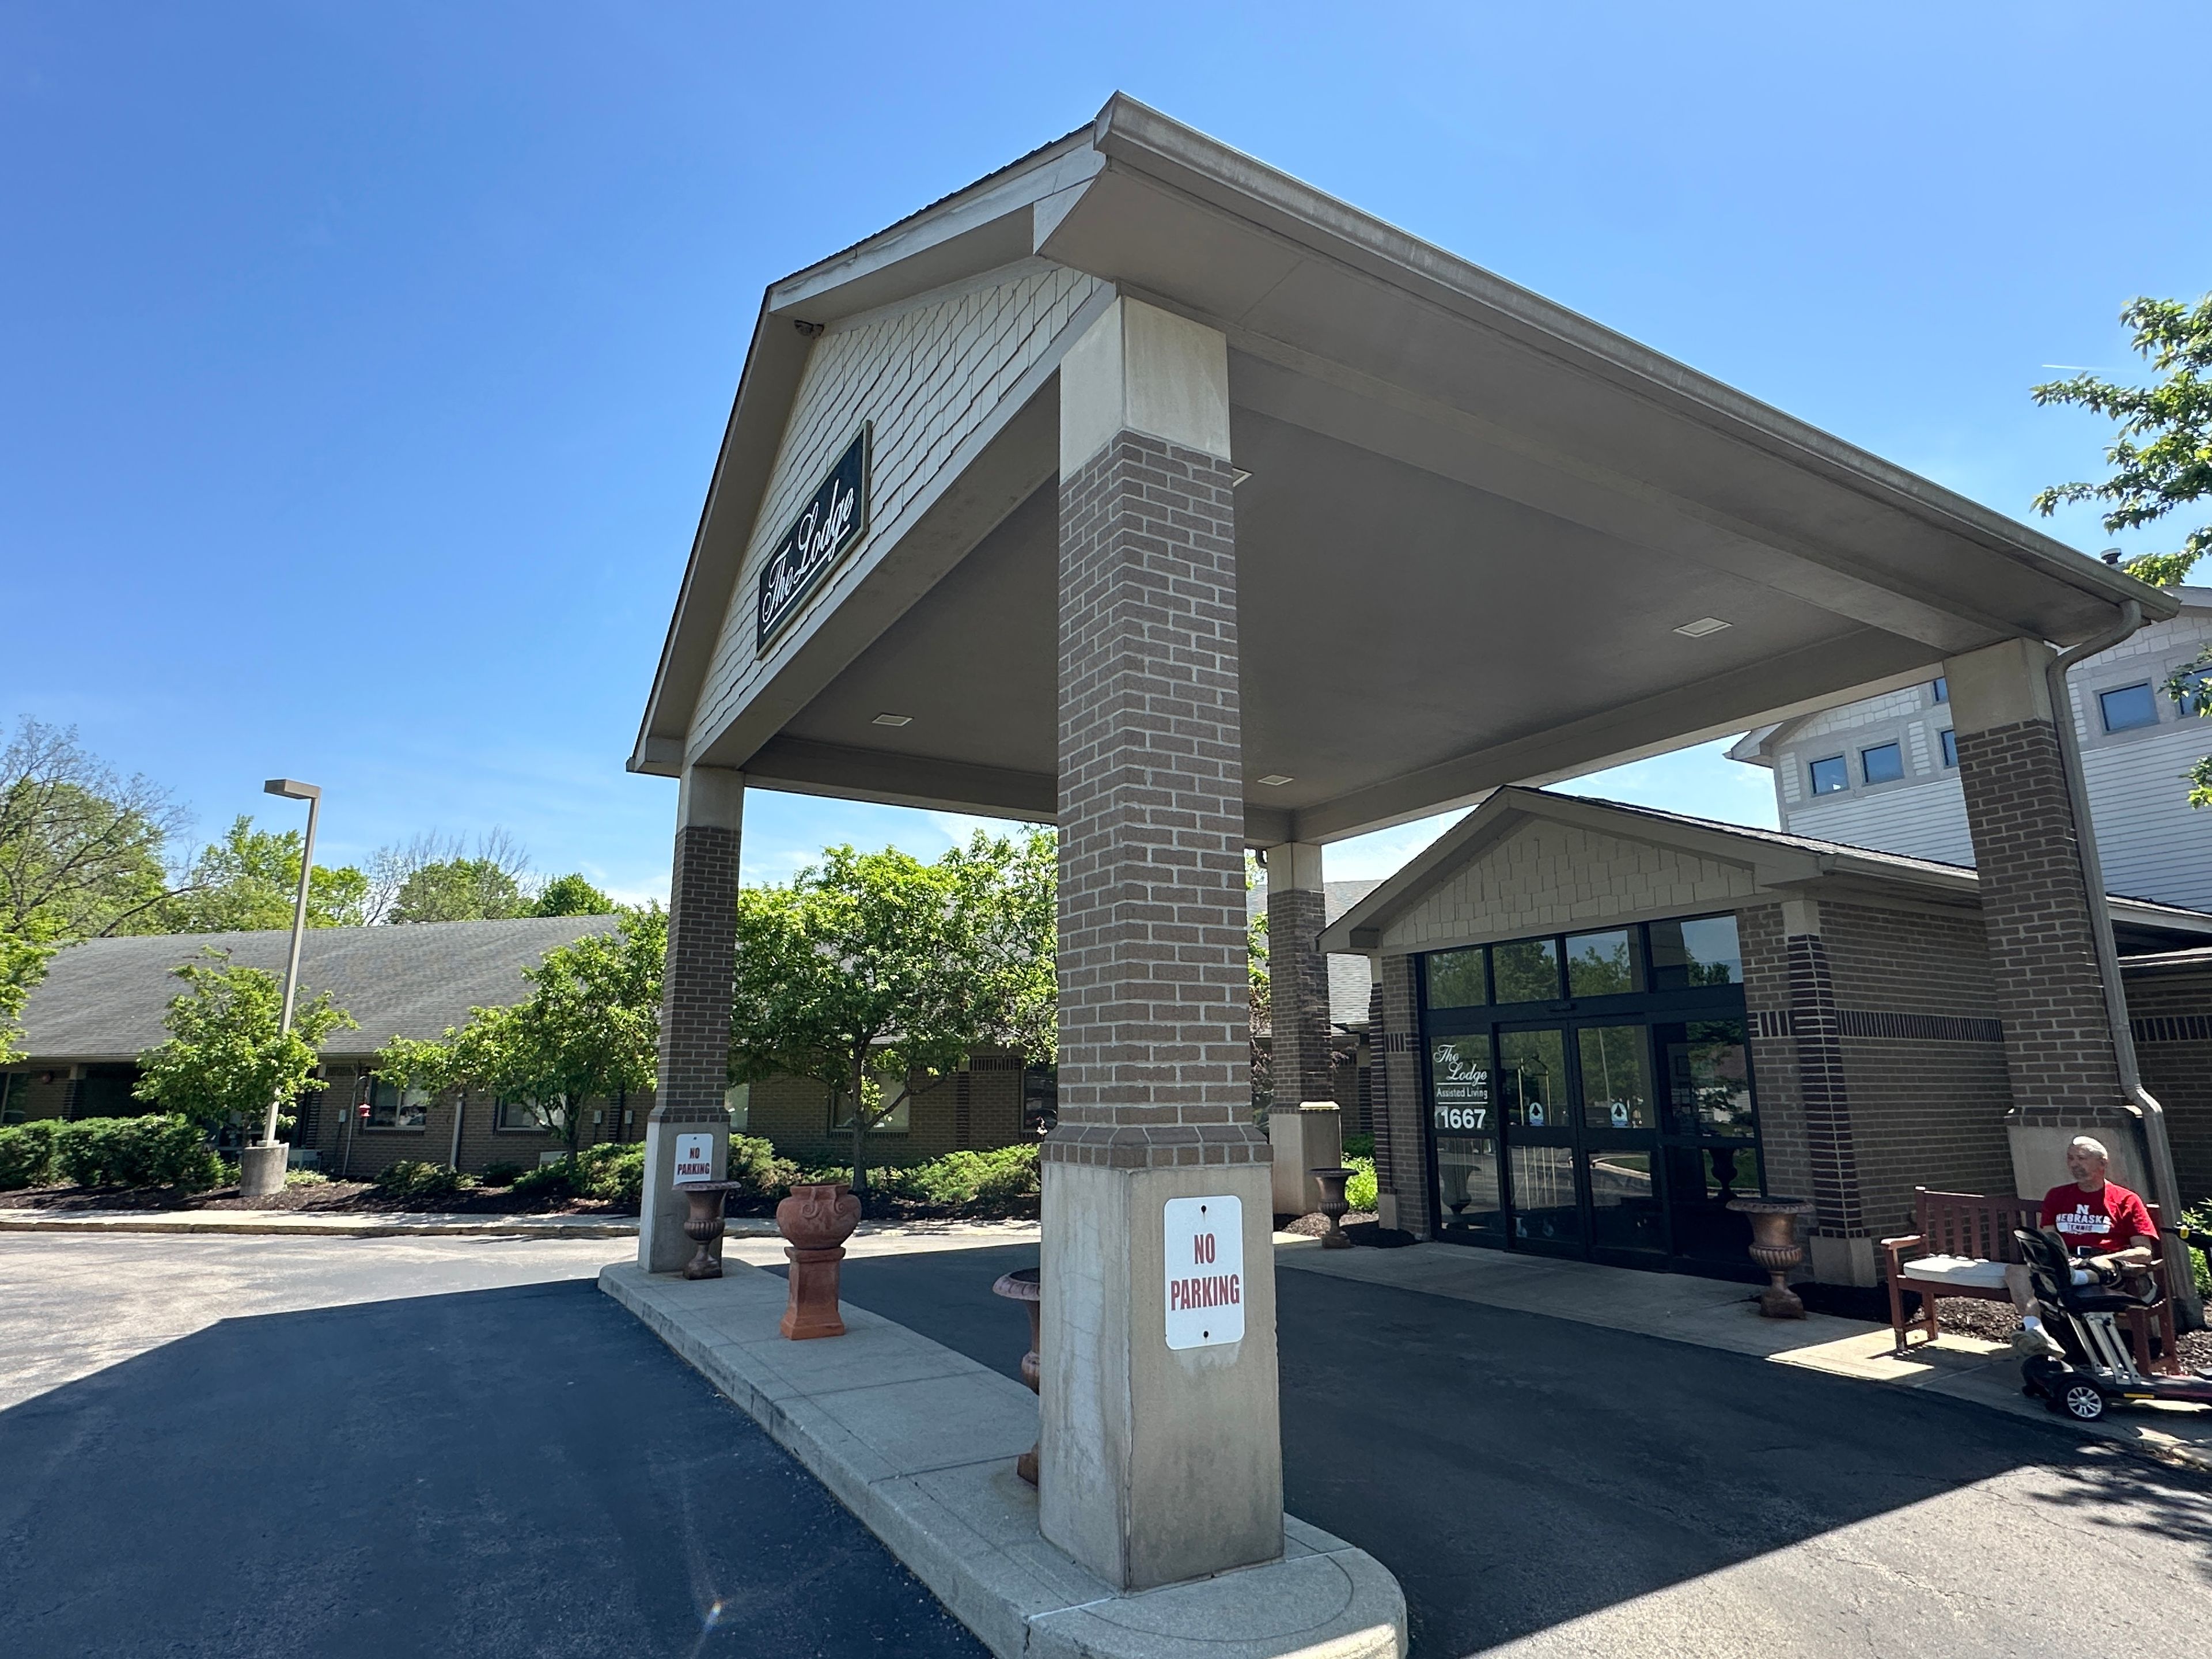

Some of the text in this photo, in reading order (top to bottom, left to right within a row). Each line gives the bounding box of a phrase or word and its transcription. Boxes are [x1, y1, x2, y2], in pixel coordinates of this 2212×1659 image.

[762, 478, 854, 623] The Lodge
[1433, 1044, 1460, 1063] The
[1446, 1062, 1487, 1086] Lodge
[1436, 1088, 1488, 1099] Assisted Living
[1441, 1109, 1486, 1128] 1667
[690, 1147, 700, 1159] NO
[677, 1162, 710, 1175] PARKING
[2076, 1204, 2090, 1215] N
[1194, 1233, 1215, 1264] NO
[1171, 1274, 1240, 1310] PARKING
